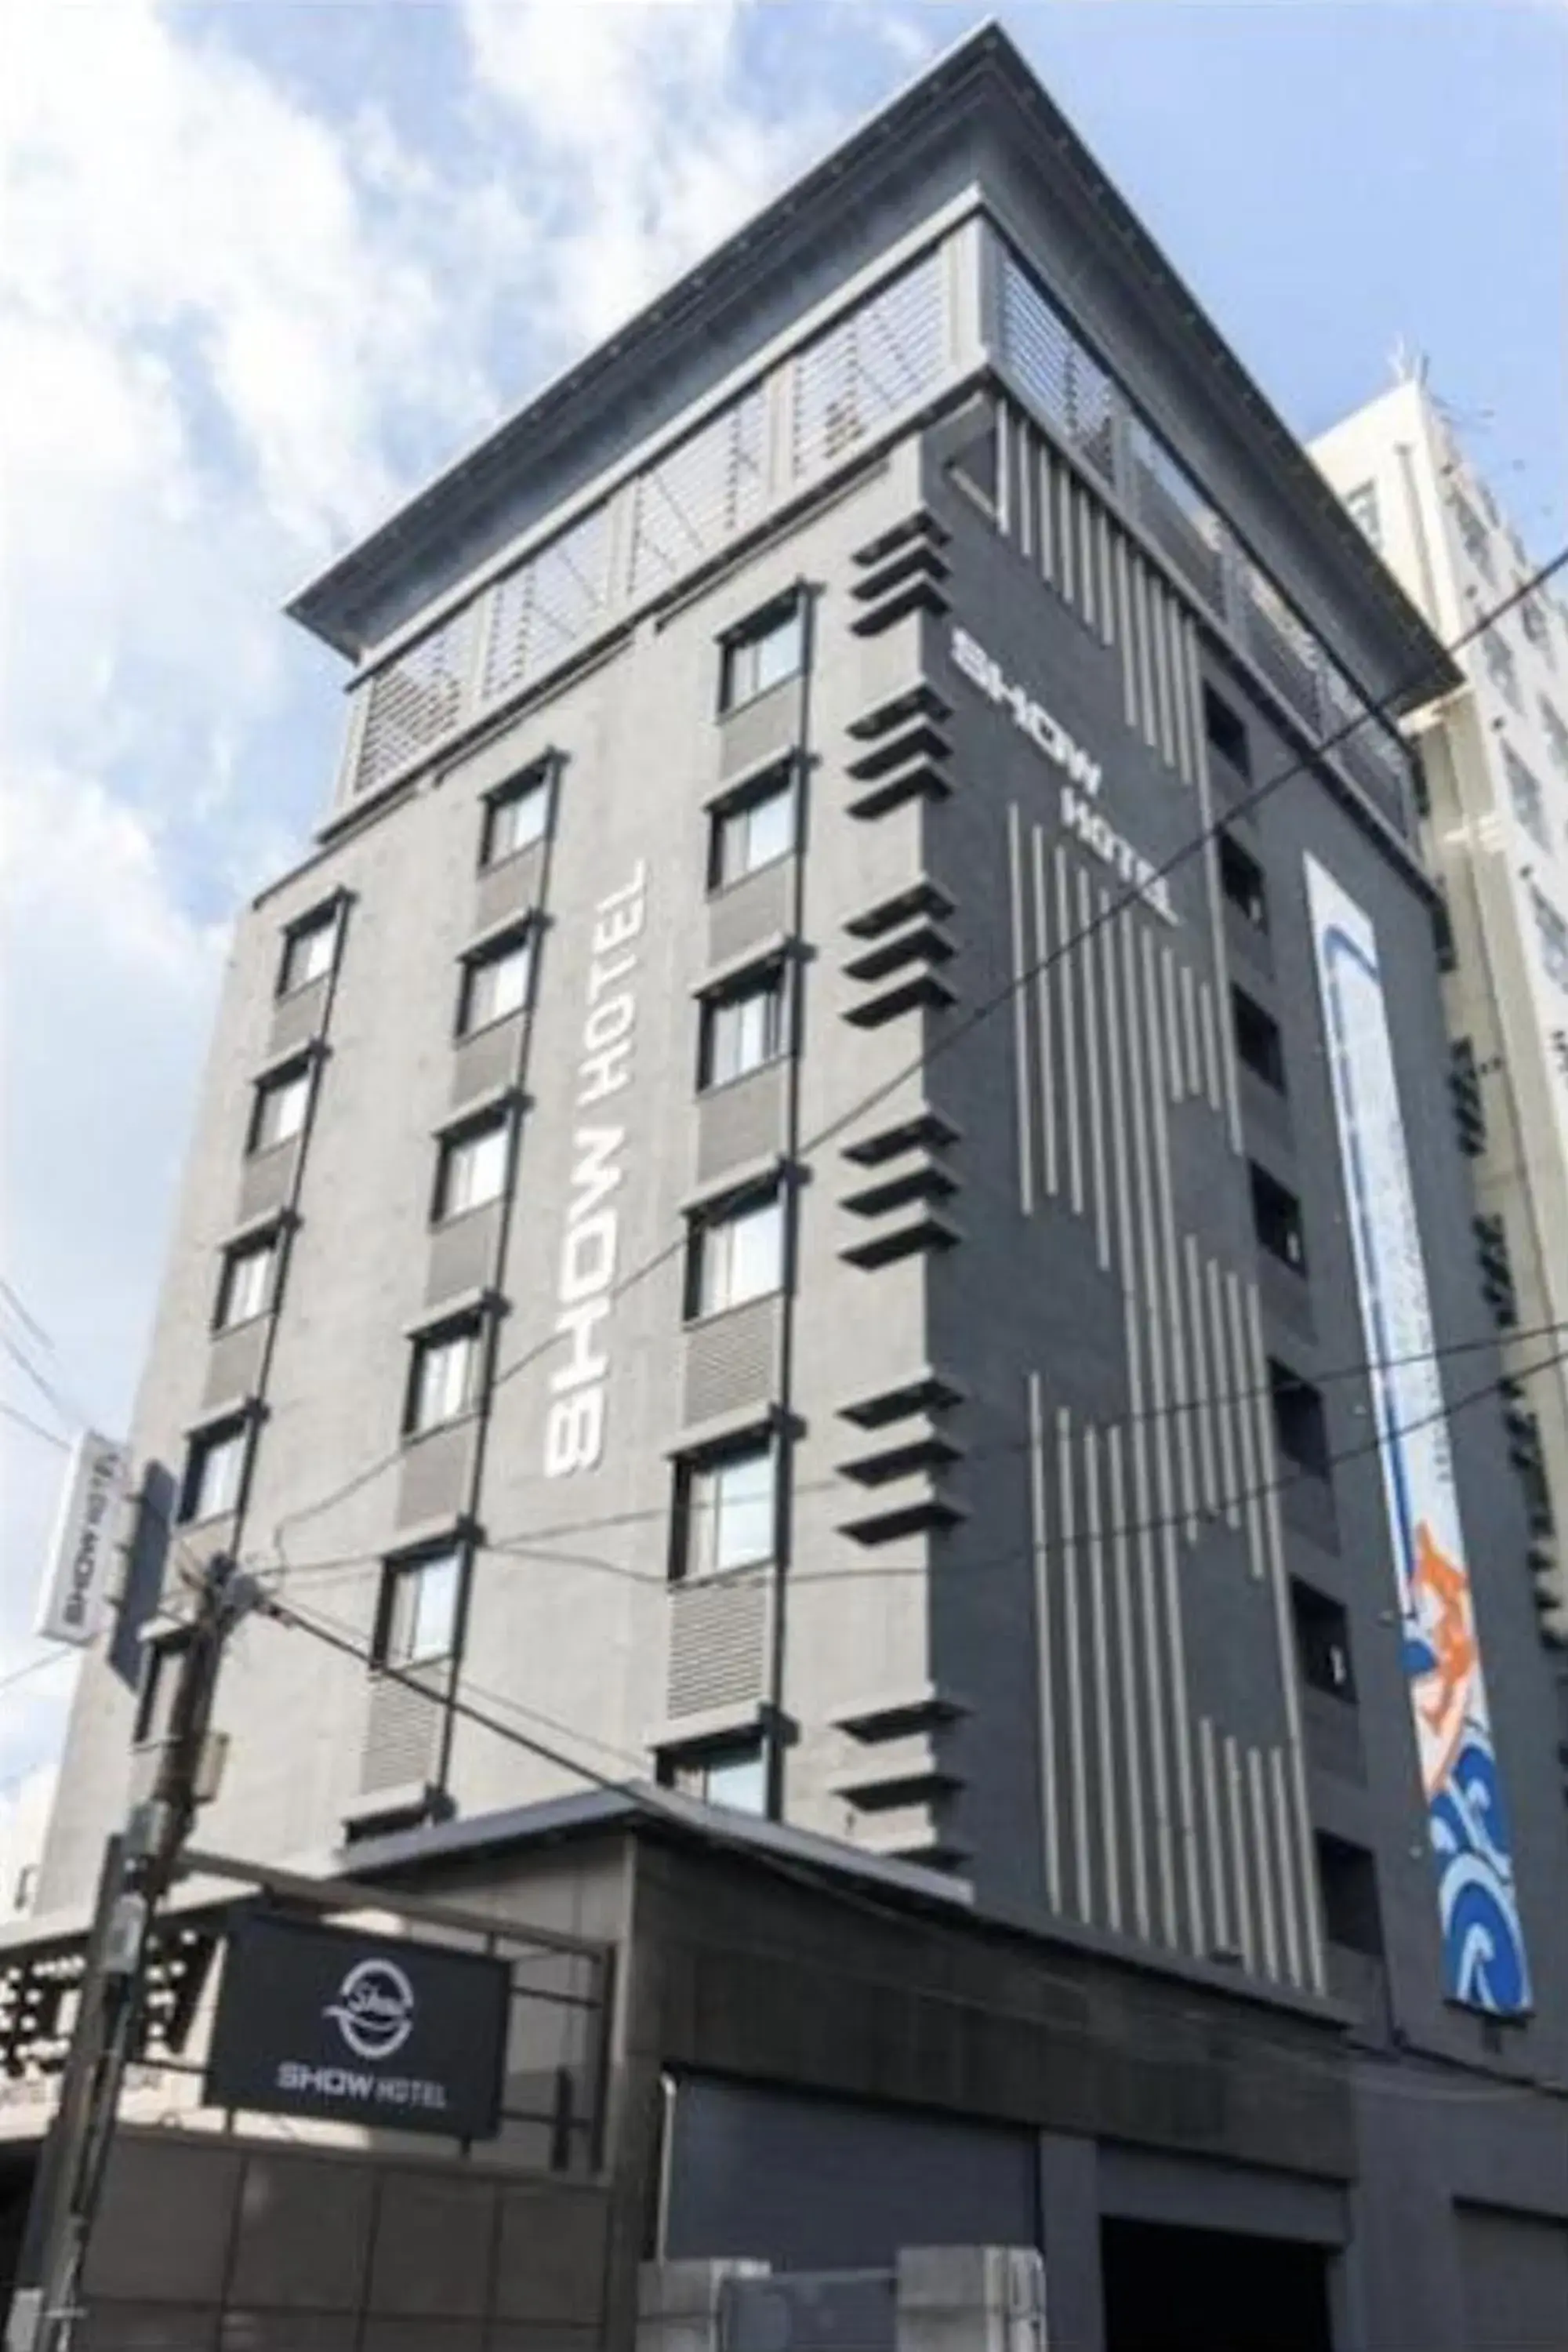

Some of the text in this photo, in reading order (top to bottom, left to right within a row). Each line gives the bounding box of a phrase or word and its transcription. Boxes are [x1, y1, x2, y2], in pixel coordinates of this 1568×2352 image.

[951, 627, 1102, 796] SHOW
[545, 857, 647, 1479] SHOW HOTEL
[277, 2060, 447, 2108] SHOW HOTEL
